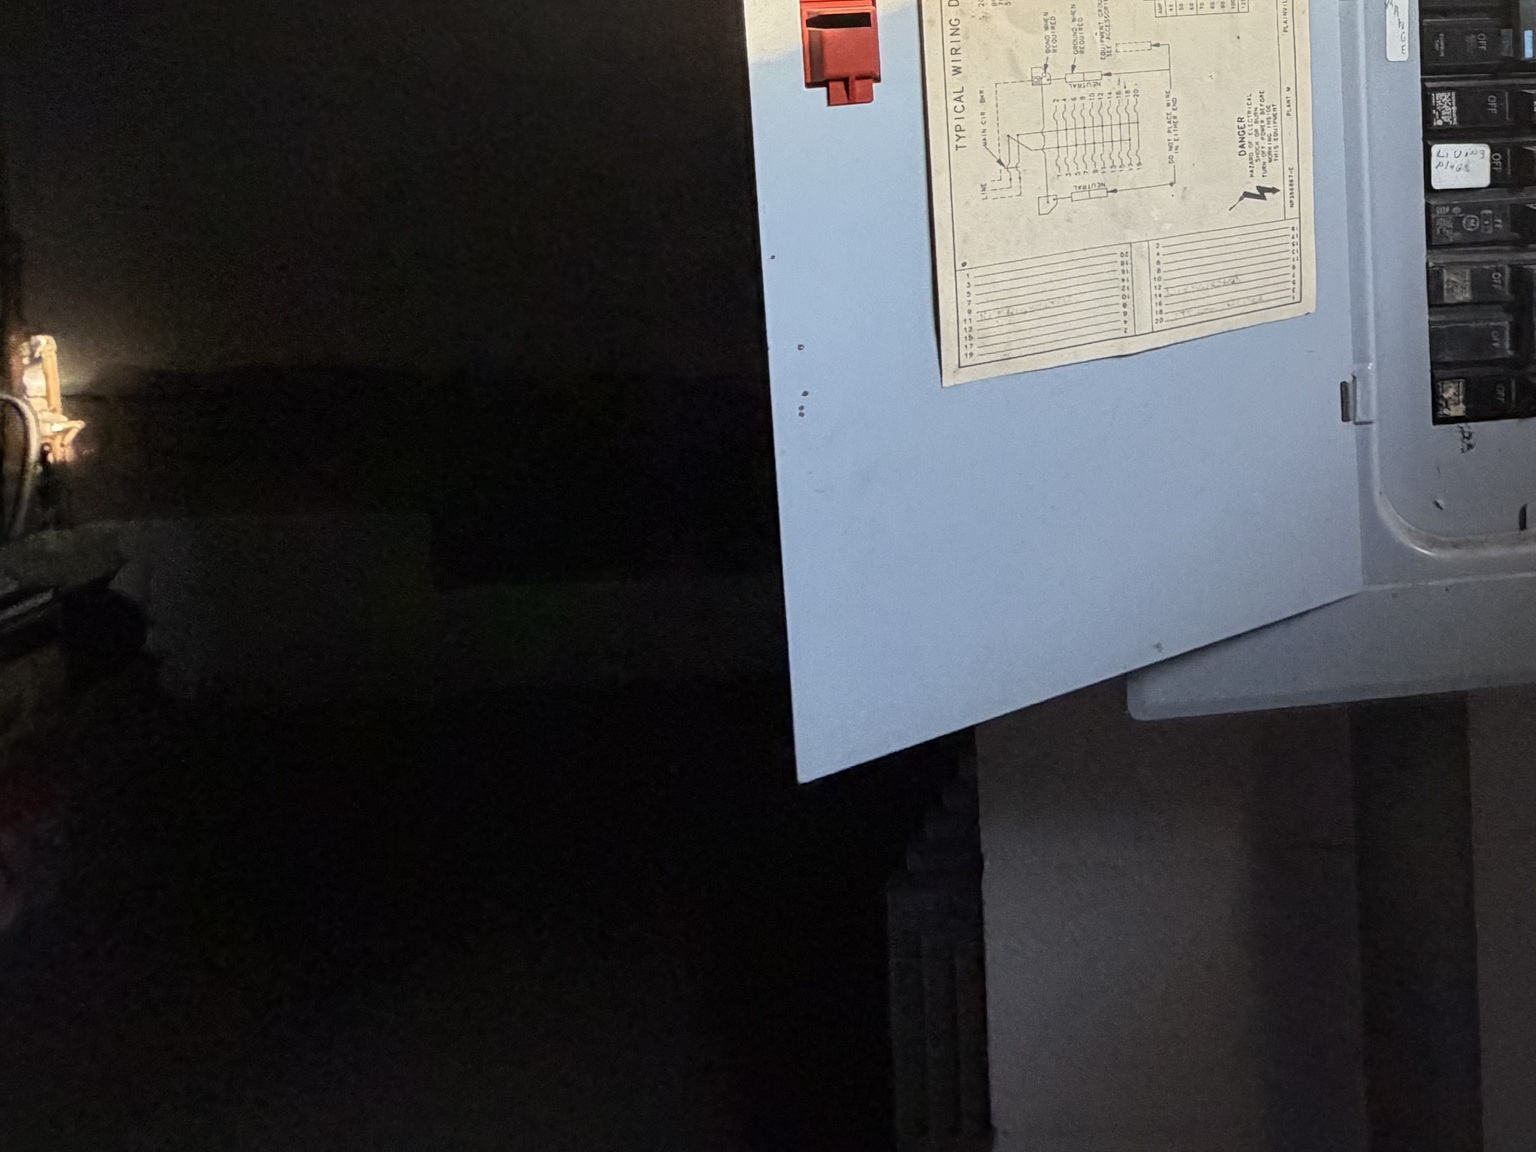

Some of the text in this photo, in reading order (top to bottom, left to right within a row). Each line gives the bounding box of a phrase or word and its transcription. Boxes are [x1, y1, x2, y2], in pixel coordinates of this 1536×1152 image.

[949, 18, 962, 76] WIRING
[1477, 33, 1486, 51] OFF
[1246, 93, 1254, 136] ELECTRICAL
[1258, 90, 1266, 115] BEFORE
[1488, 95, 1498, 114] OFF
[952, 86, 966, 150] TYPICAL
[1238, 116, 1247, 157] DANGER
[1248, 140, 1254, 148] OF
[1266, 134, 1274, 163] WORKING
[1492, 152, 1502, 172] OFF
